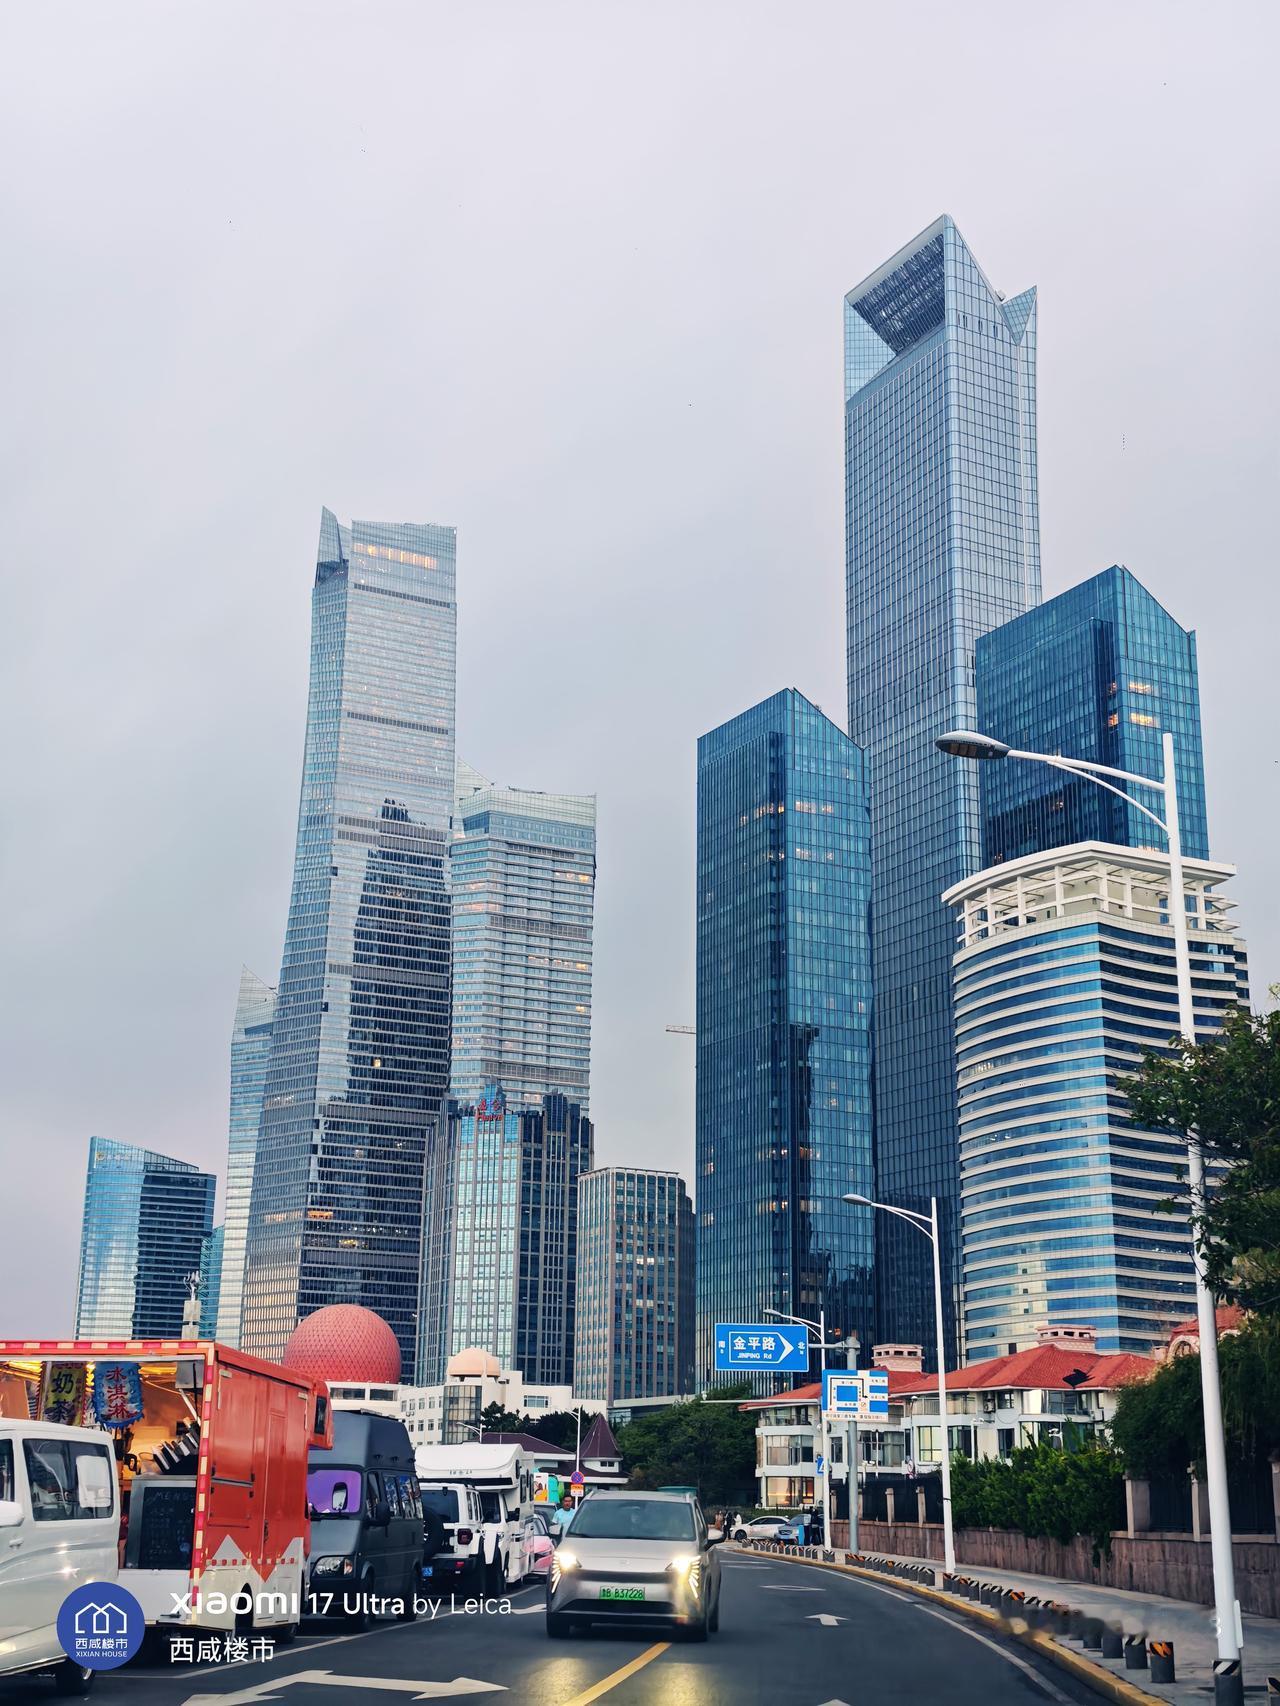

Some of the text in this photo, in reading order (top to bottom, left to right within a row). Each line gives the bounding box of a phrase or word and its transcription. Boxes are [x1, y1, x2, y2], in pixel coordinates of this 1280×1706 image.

[733, 1336, 776, 1351] 金平路
[45, 1371, 74, 1421] 奶茶
[105, 1366, 129, 1419] 冰淇淋
